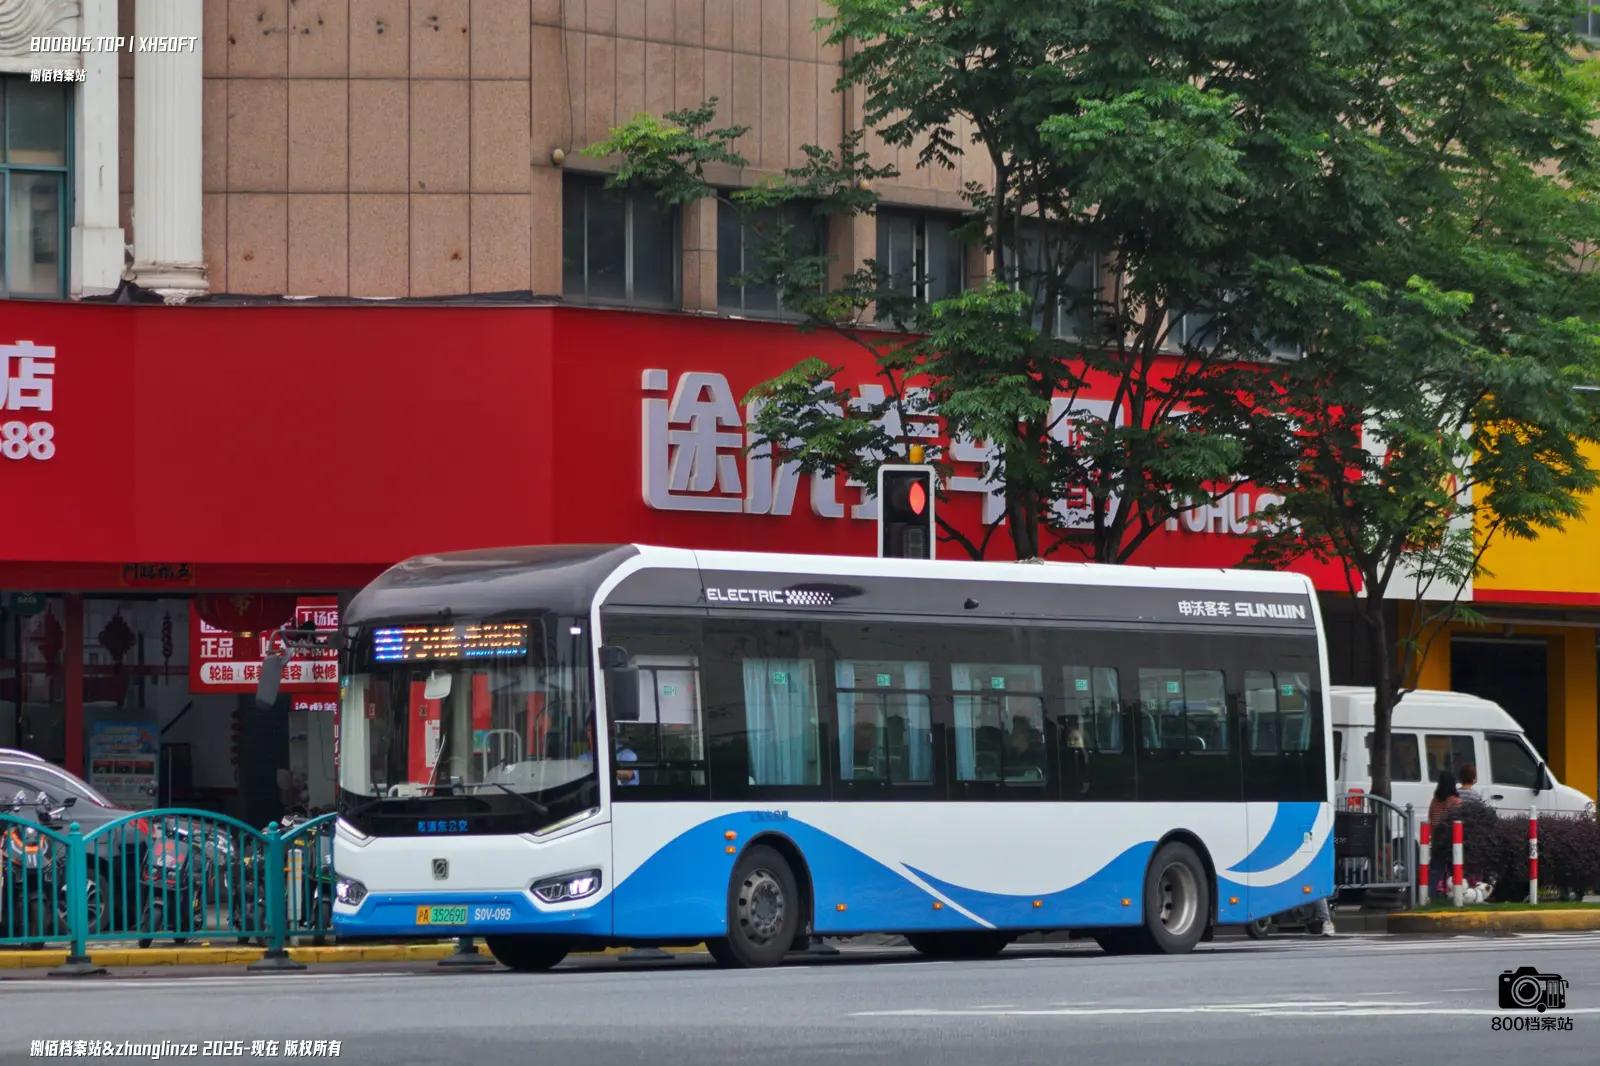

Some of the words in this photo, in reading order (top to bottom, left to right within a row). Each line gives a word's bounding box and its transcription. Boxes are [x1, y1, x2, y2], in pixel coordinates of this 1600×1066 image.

[0, 340, 55, 411] 店
[0, 421, 55, 460] 88
[706, 588, 784, 603] ELECTRIC
[1178, 600, 1232, 617] 申沃客车
[1234, 602, 1306, 619] SUNWIN
[200, 637, 233, 658] 正品
[209, 665, 234, 680] 轮胎
[311, 664, 337, 680] 快修
